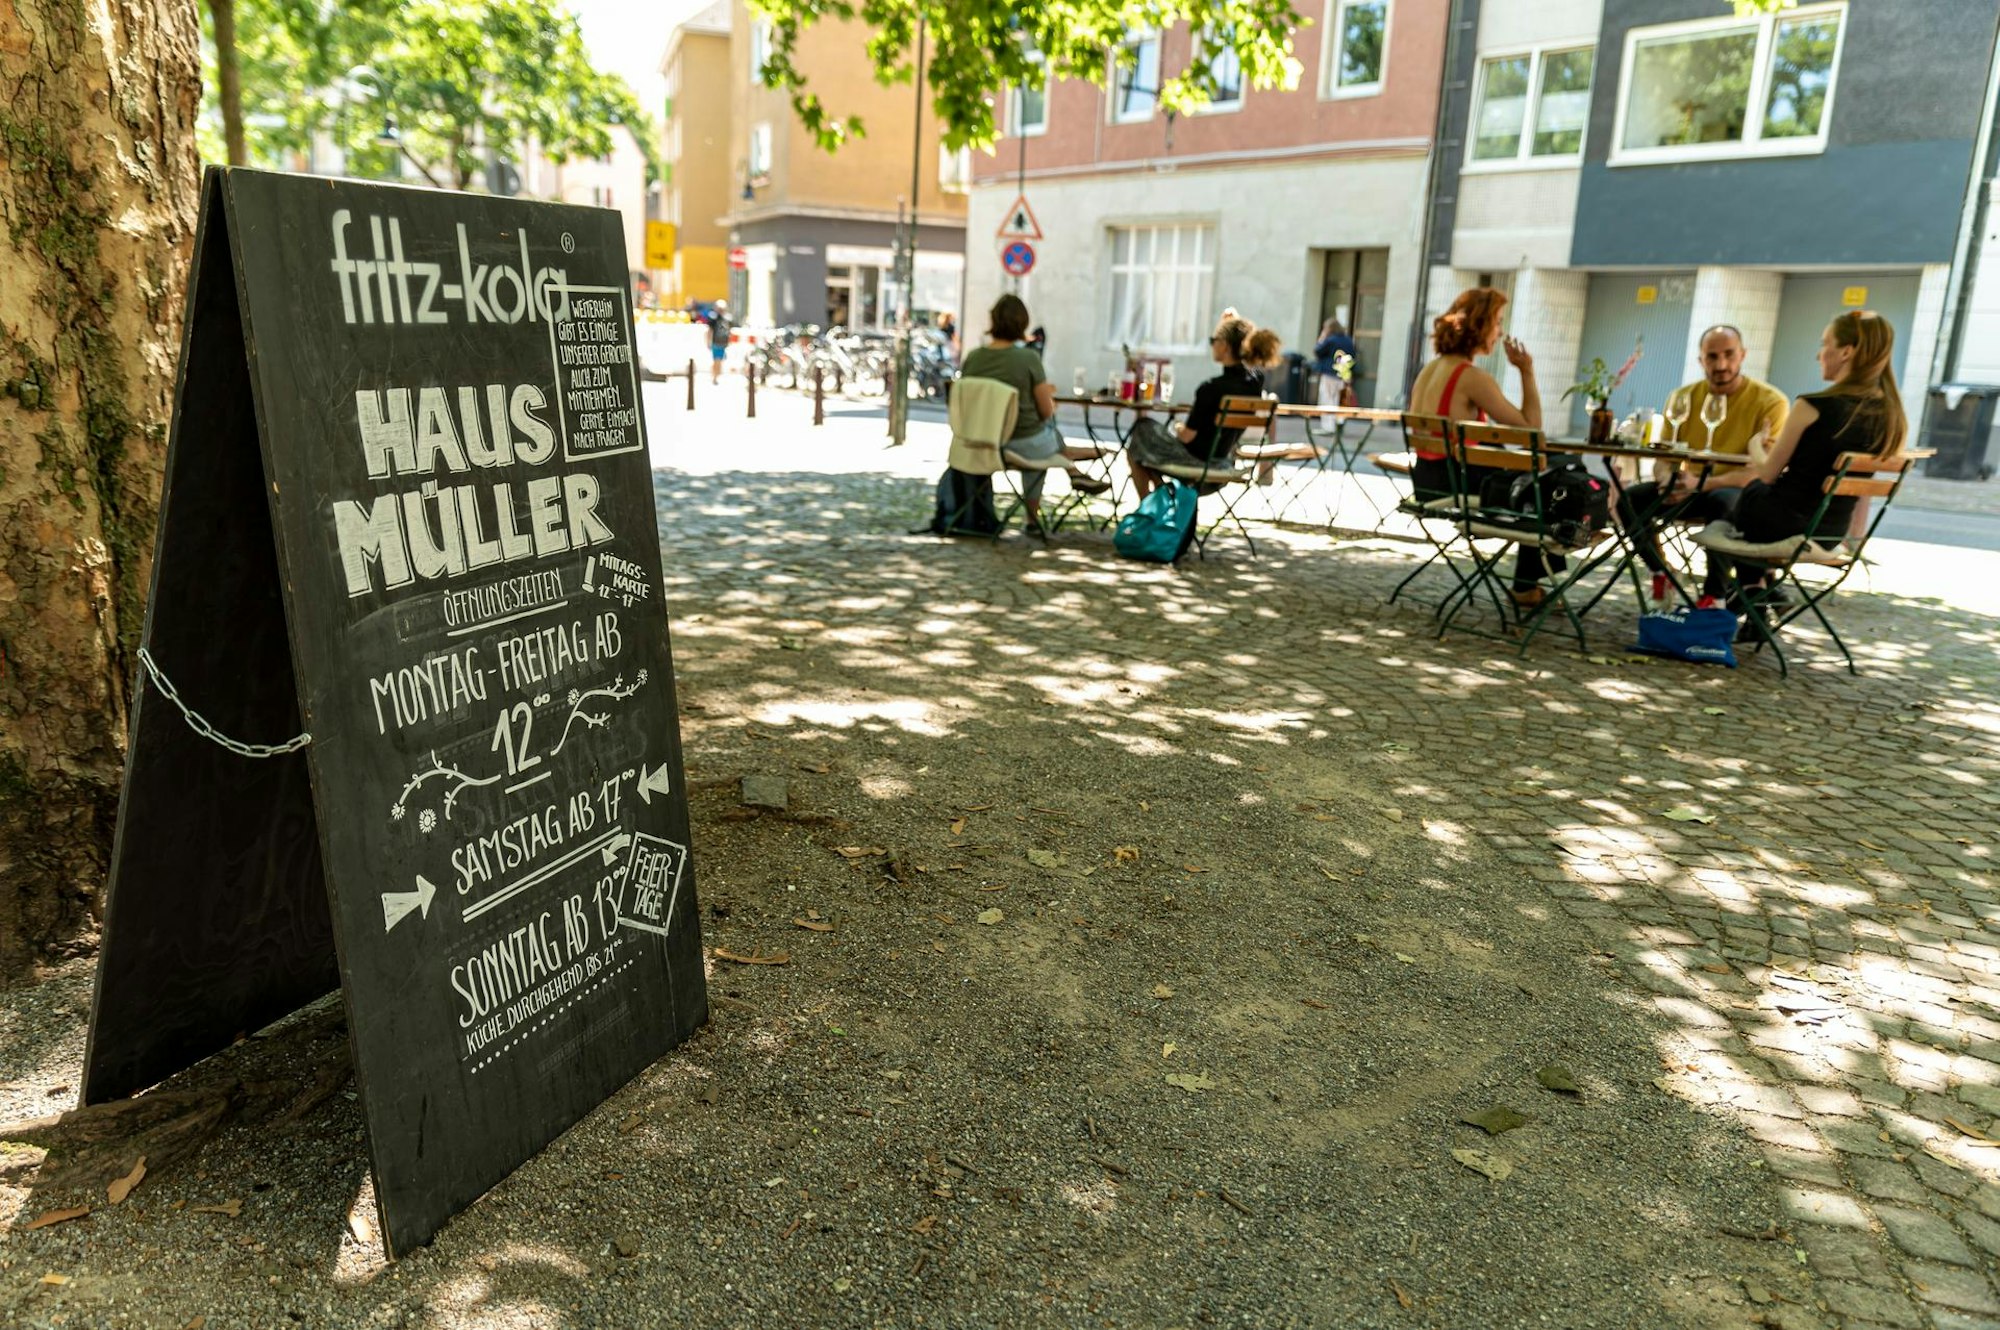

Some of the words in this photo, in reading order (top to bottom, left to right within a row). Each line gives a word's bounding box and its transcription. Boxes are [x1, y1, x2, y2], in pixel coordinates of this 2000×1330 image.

[331, 209, 572, 324] fritz-kola
[571, 298, 614, 318] WEITERHIN
[558, 321, 577, 341] GIBT
[577, 321, 589, 342] ES
[589, 319, 619, 342] EINIGE
[560, 344, 600, 365] UNSERER
[571, 368, 592, 389] AUCH
[592, 366, 613, 388] ZUM
[567, 385, 625, 411] MITNEHMEN.
[355, 384, 557, 480] HAUS
[580, 412, 606, 430] GERNE
[607, 408, 636, 428] EINFACH
[573, 432, 595, 449] NACH
[595, 428, 630, 447] FRAGEN.
[333, 473, 615, 598] MÜLLER
[599, 551, 648, 579] MITTAGS-
[443, 568, 565, 626] ÖFFNUNGSZEITEN
[613, 573, 651, 599] KARTE
[595, 612, 622, 660] AB
[451, 805, 564, 895] SAMSTAG
[569, 791, 595, 838] AB
[631, 845, 676, 892] FEIER-
[633, 883, 664, 920] TAGE
[451, 911, 562, 1027] SONNTAG
[563, 894, 588, 960] AB
[466, 1013, 505, 1056] KÜCHE
